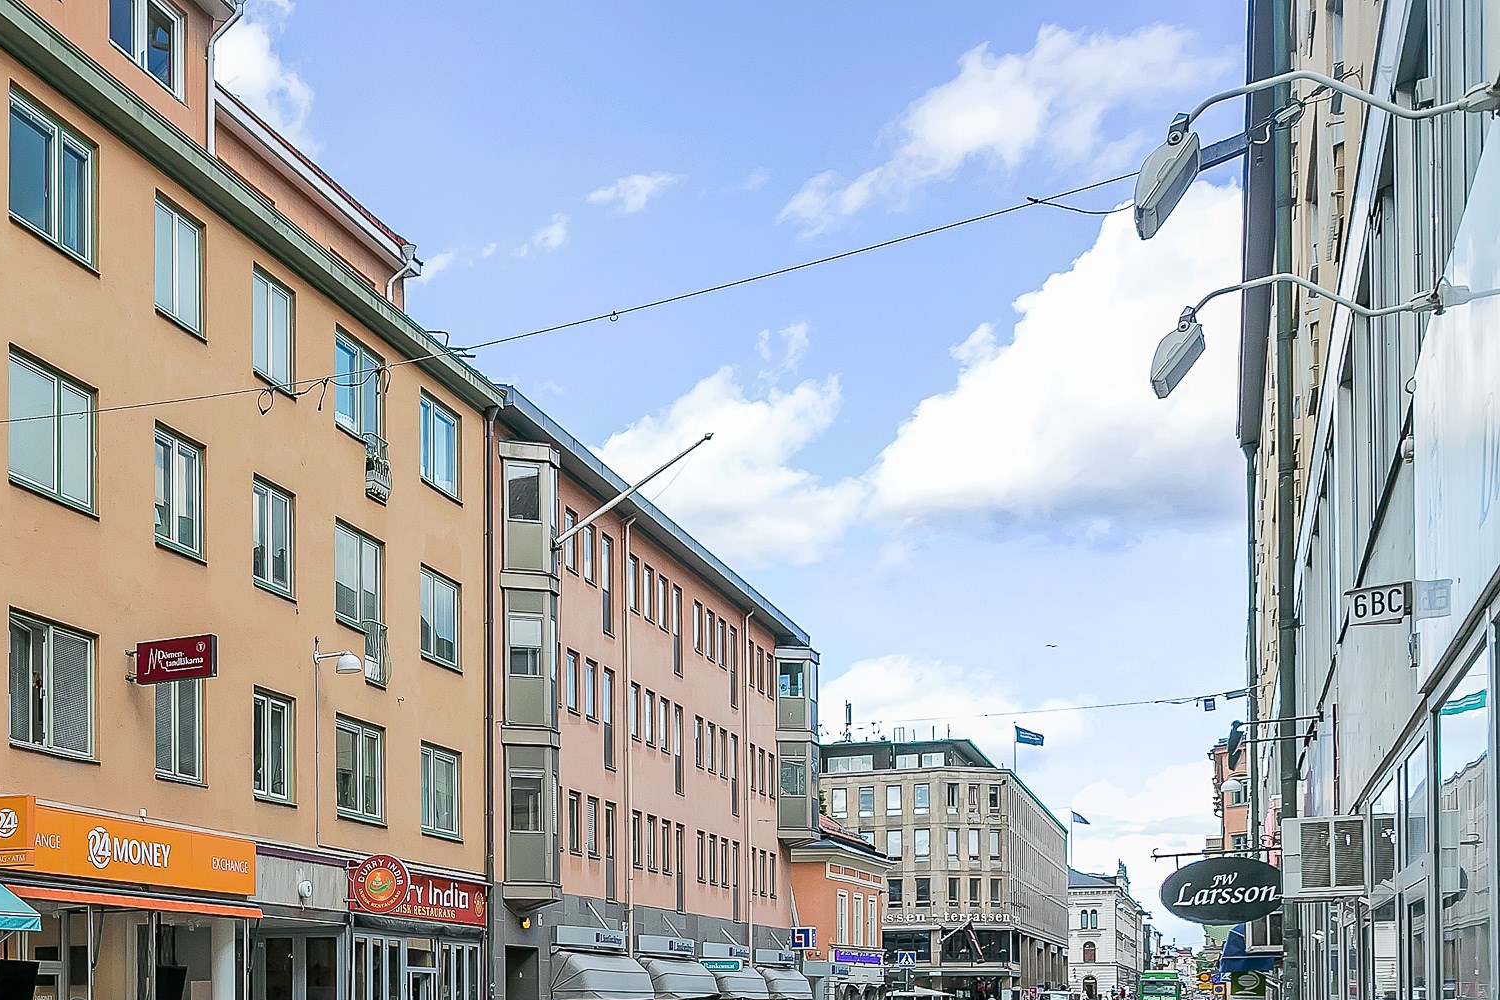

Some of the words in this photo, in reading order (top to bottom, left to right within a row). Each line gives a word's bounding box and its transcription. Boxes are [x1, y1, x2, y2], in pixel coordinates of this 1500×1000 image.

[11, 853, 26, 863] ATM
[113, 837, 172, 869] MONEY
[212, 856, 249, 875] EXCHANGE
[386, 861, 404, 886] INDIA
[428, 880, 469, 910] India
[1173, 883, 1277, 906] Larsson
[413, 905, 456, 919] RESTAURANG
[944, 911, 1010, 922] terrassen
